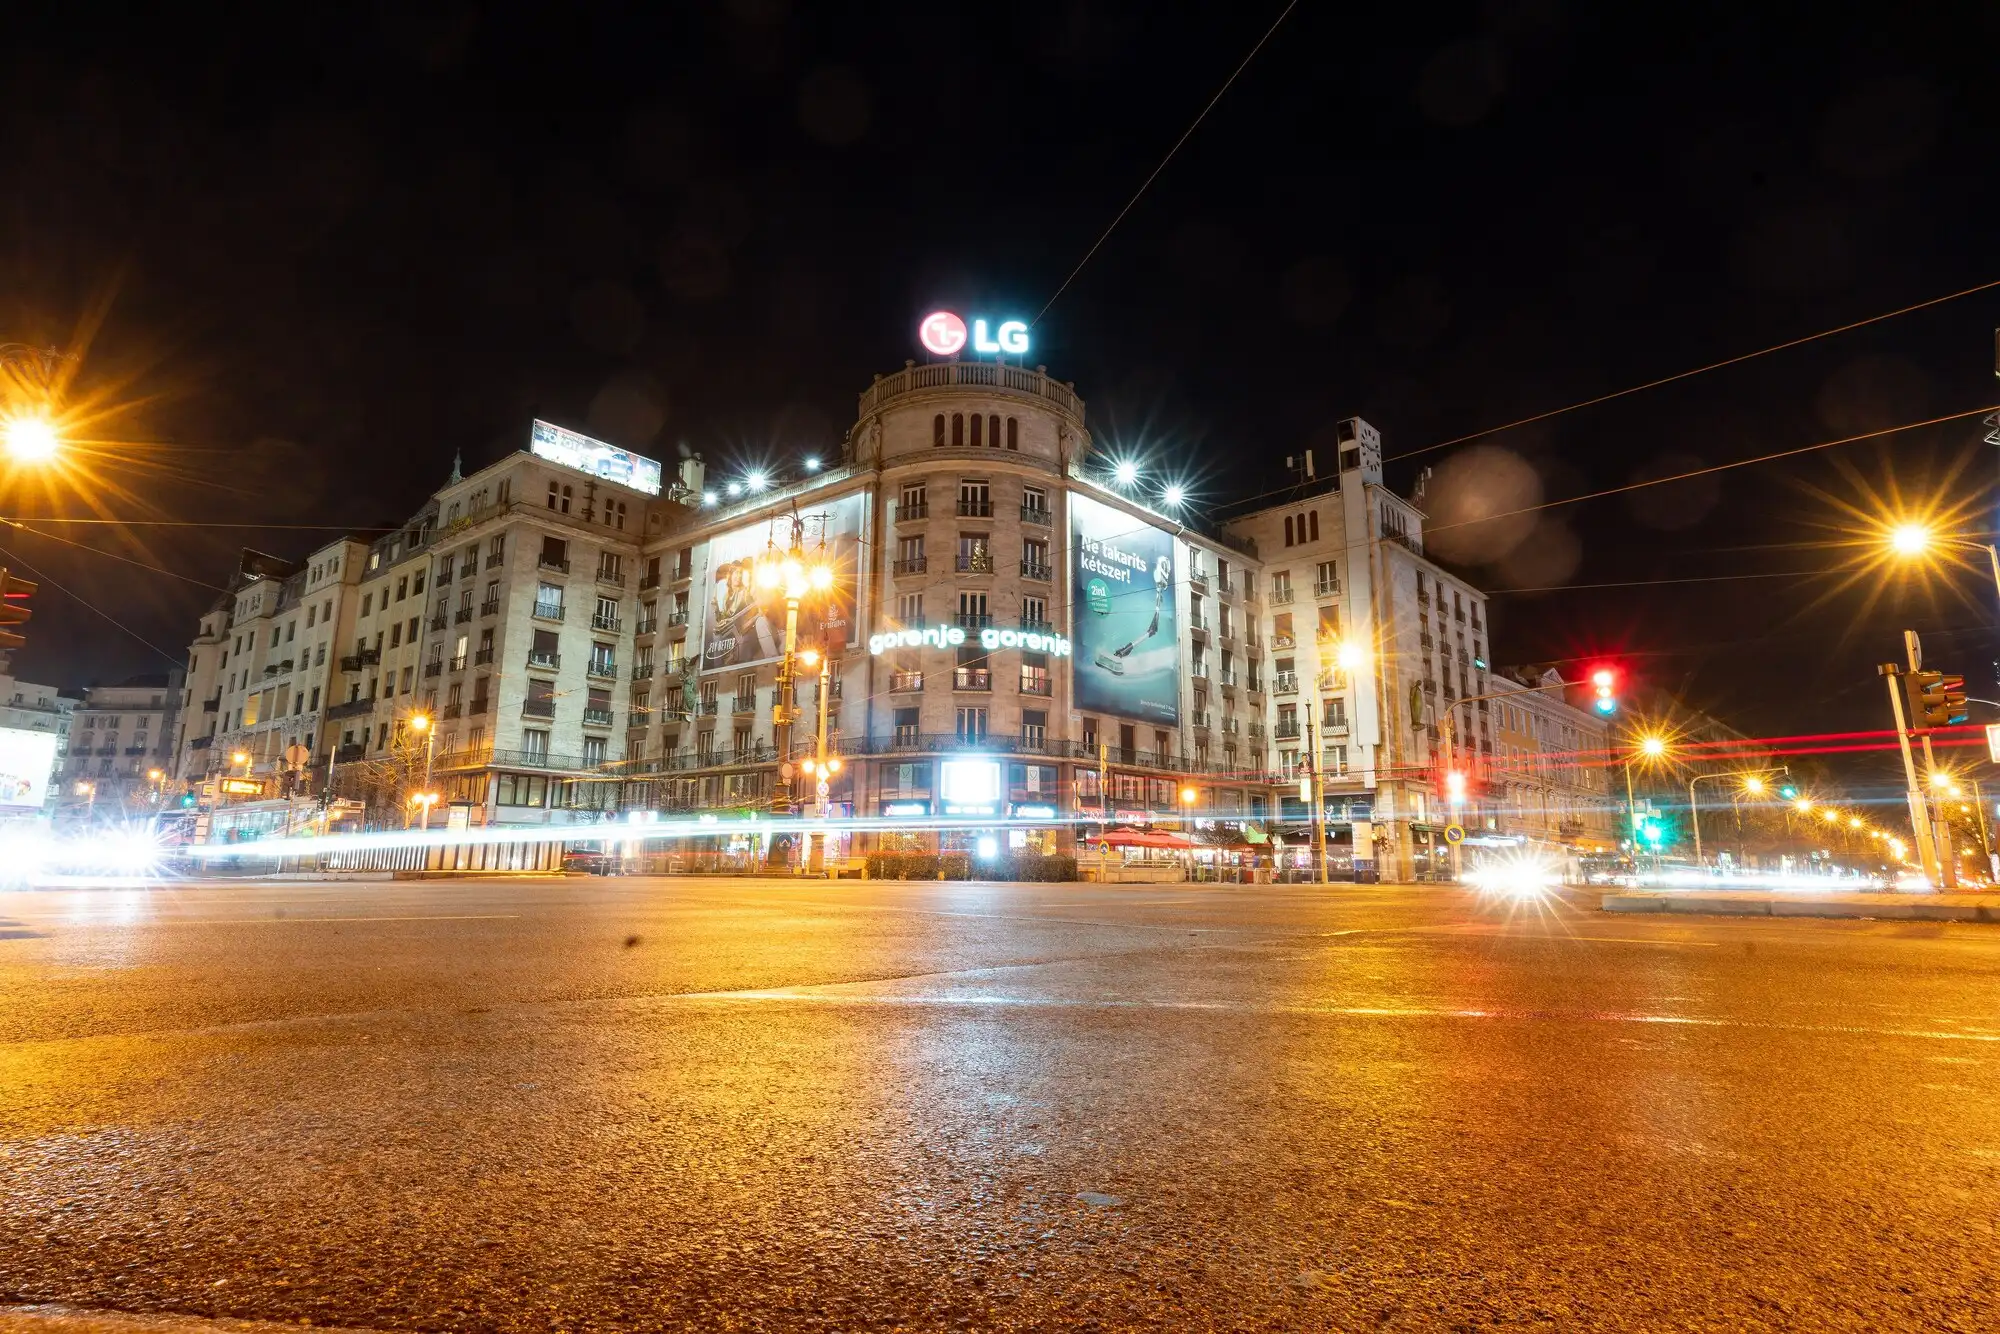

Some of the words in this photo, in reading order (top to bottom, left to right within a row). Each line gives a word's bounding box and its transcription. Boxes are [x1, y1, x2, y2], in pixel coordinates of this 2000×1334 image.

[975, 319, 1029, 353] LG
[1081, 533, 1099, 554] Ne
[1081, 551, 1131, 584] kétszer!
[869, 624, 965, 655] gorenje
[981, 628, 1072, 656] gorenje
